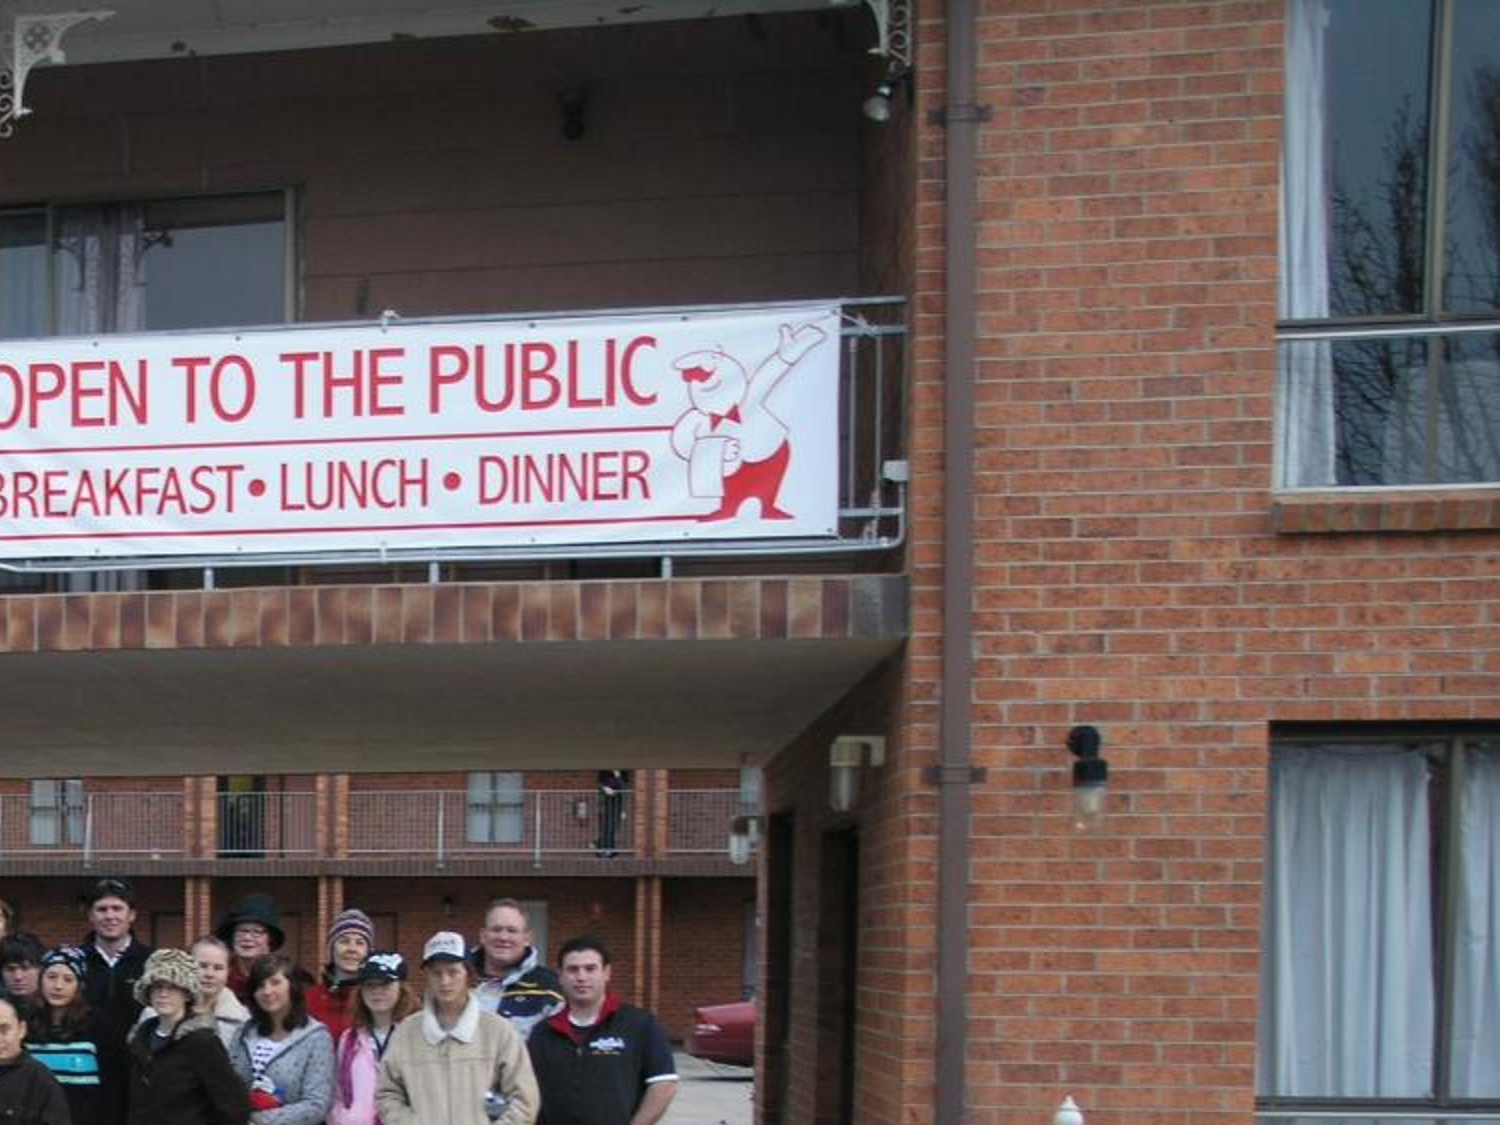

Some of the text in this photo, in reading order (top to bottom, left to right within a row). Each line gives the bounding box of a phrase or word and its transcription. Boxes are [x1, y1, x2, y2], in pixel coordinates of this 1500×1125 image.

[172, 355, 256, 422] TO
[279, 348, 405, 418] THE
[429, 336, 657, 414] PUBLIC
[280, 458, 428, 510] LUNCH
[478, 450, 651, 504] DINNER
